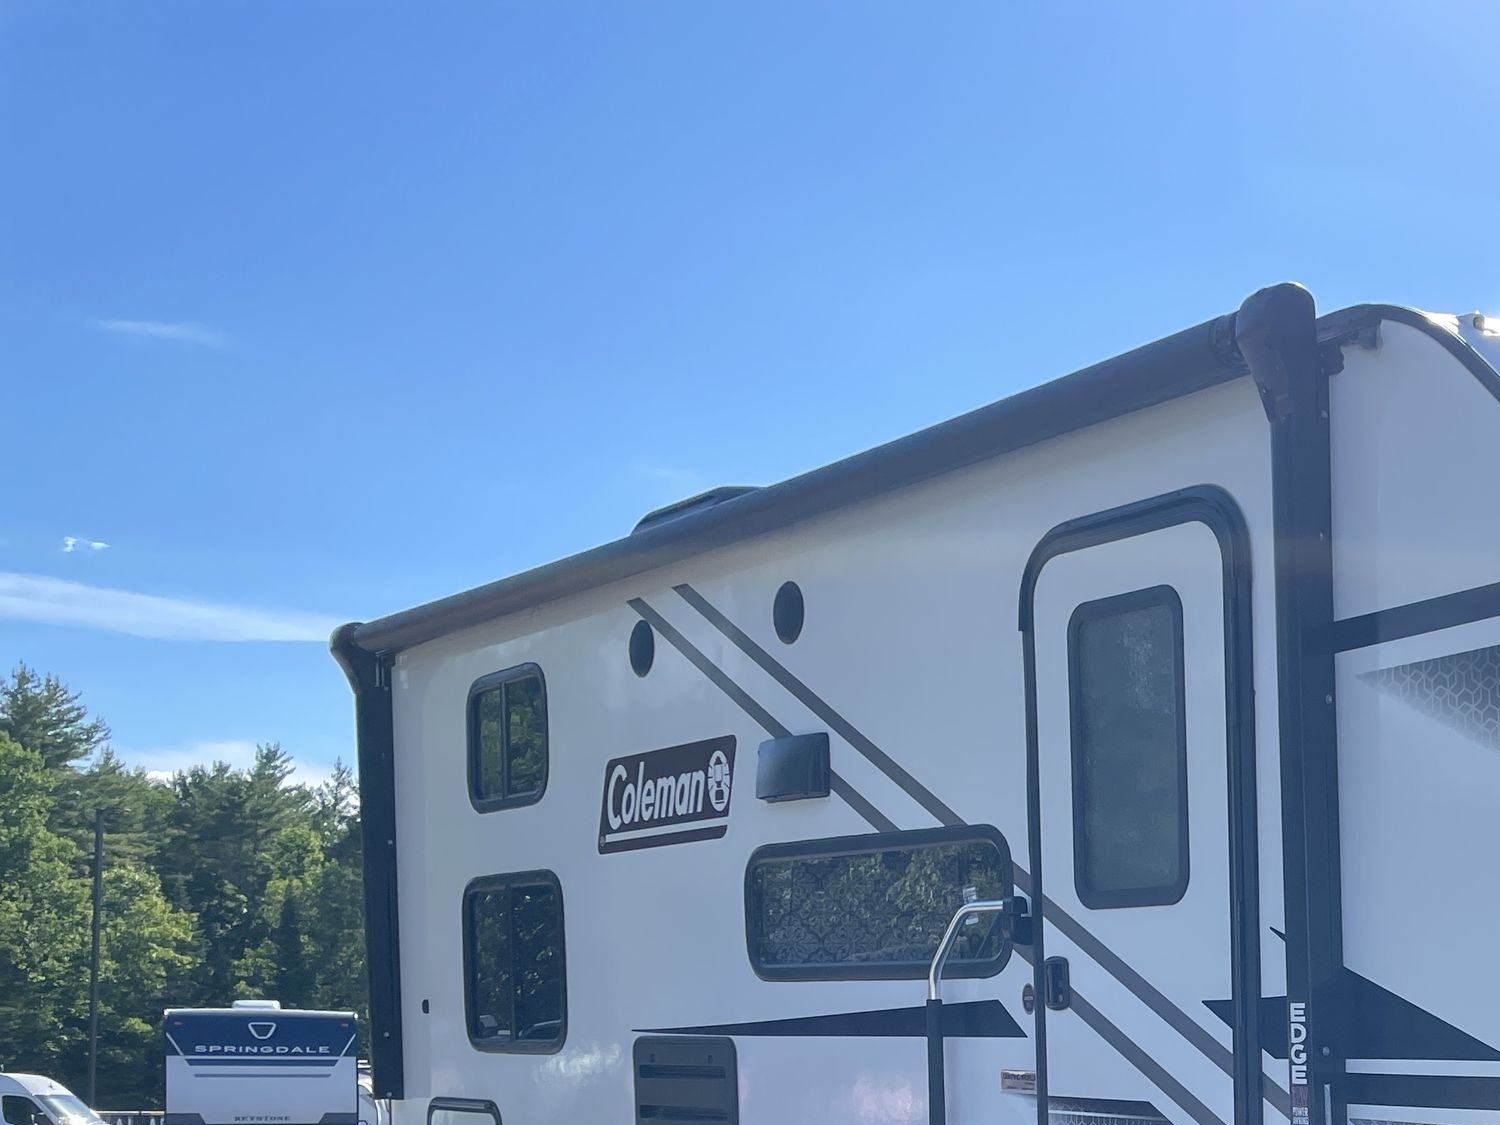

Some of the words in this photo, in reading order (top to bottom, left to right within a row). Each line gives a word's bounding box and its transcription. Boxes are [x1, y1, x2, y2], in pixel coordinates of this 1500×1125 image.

[607, 761, 706, 831] Coleman
[194, 1045, 331, 1054] SPRINGDALE
[1290, 1002, 1308, 1085] EDGE
